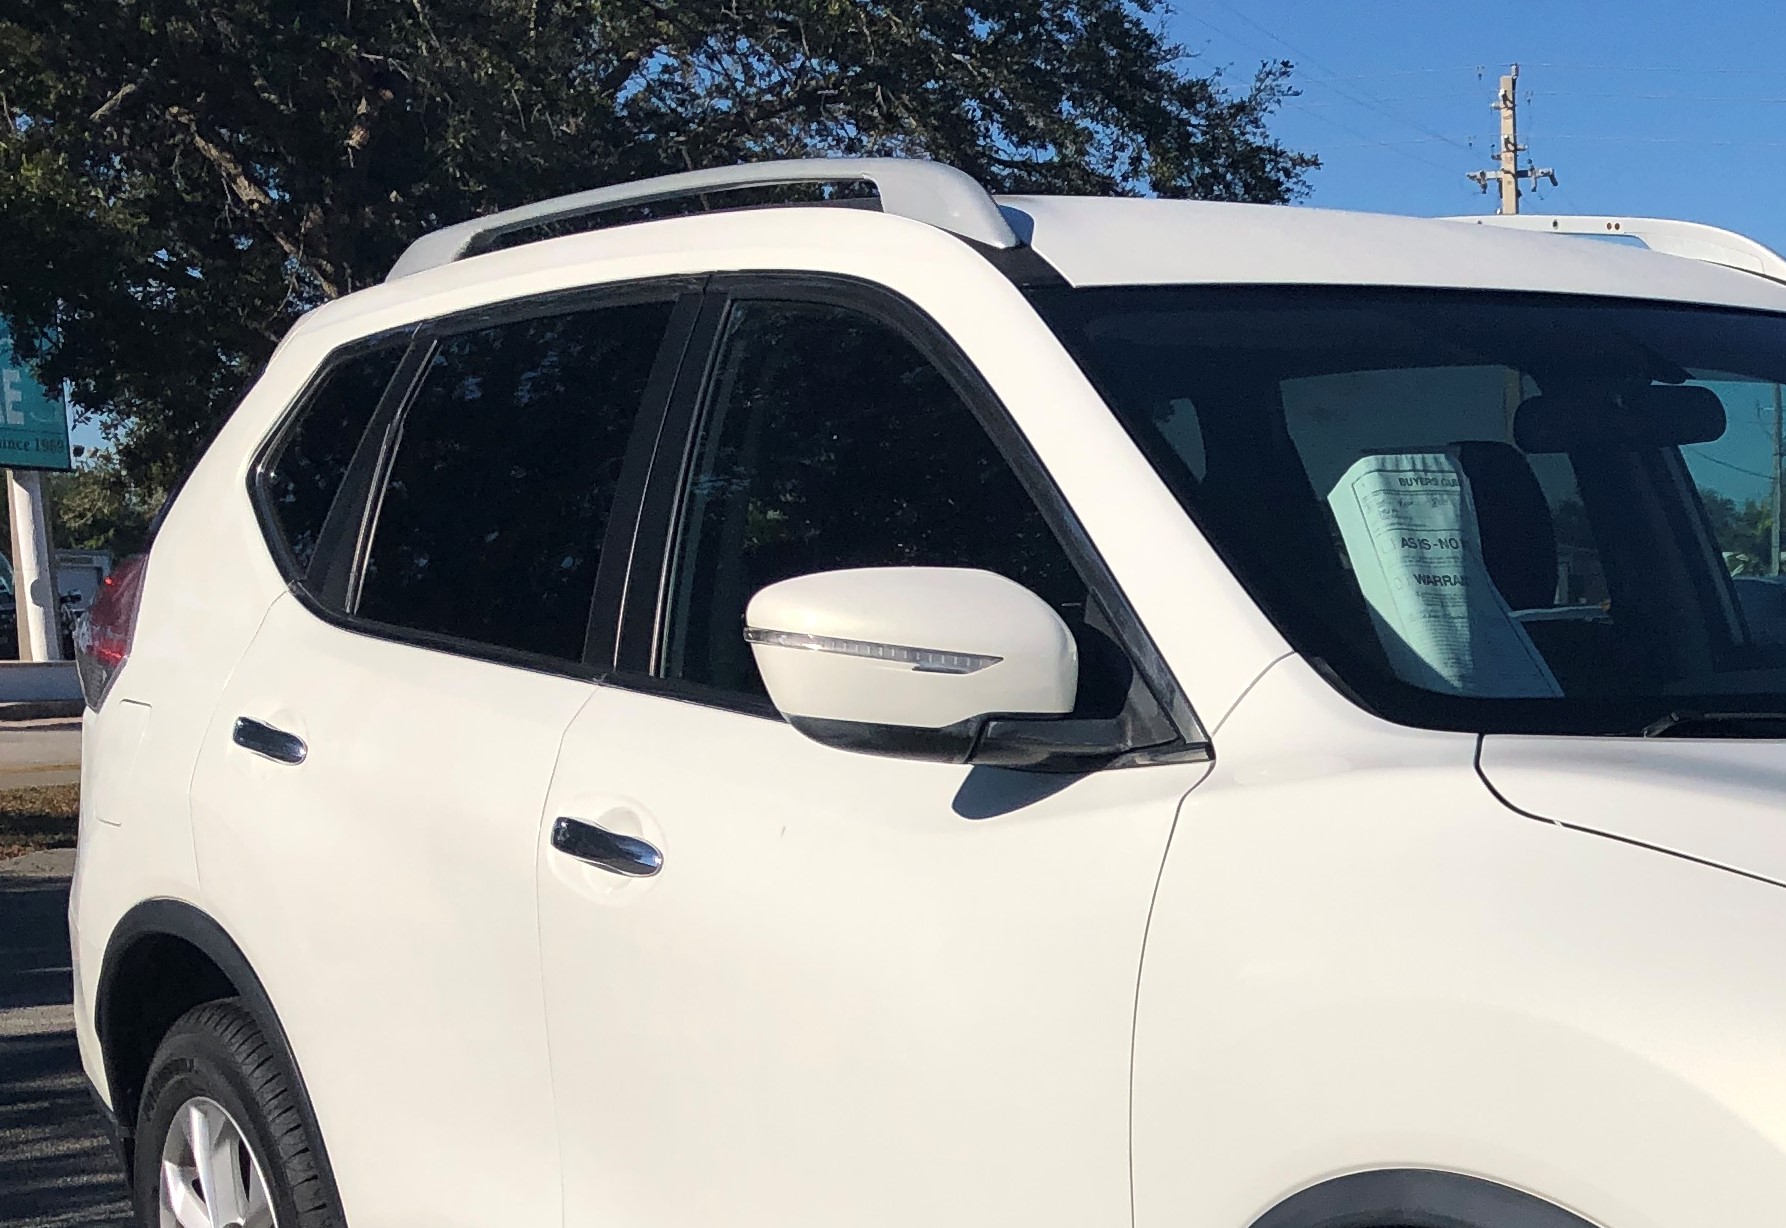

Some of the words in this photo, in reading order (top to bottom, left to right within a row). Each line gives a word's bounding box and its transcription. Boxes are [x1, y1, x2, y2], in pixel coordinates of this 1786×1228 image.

[1398, 476, 1439, 487] BUYERS
[1401, 536, 1418, 549] AS
[1418, 537, 1432, 550] IS
[1438, 537, 1459, 550] NO
